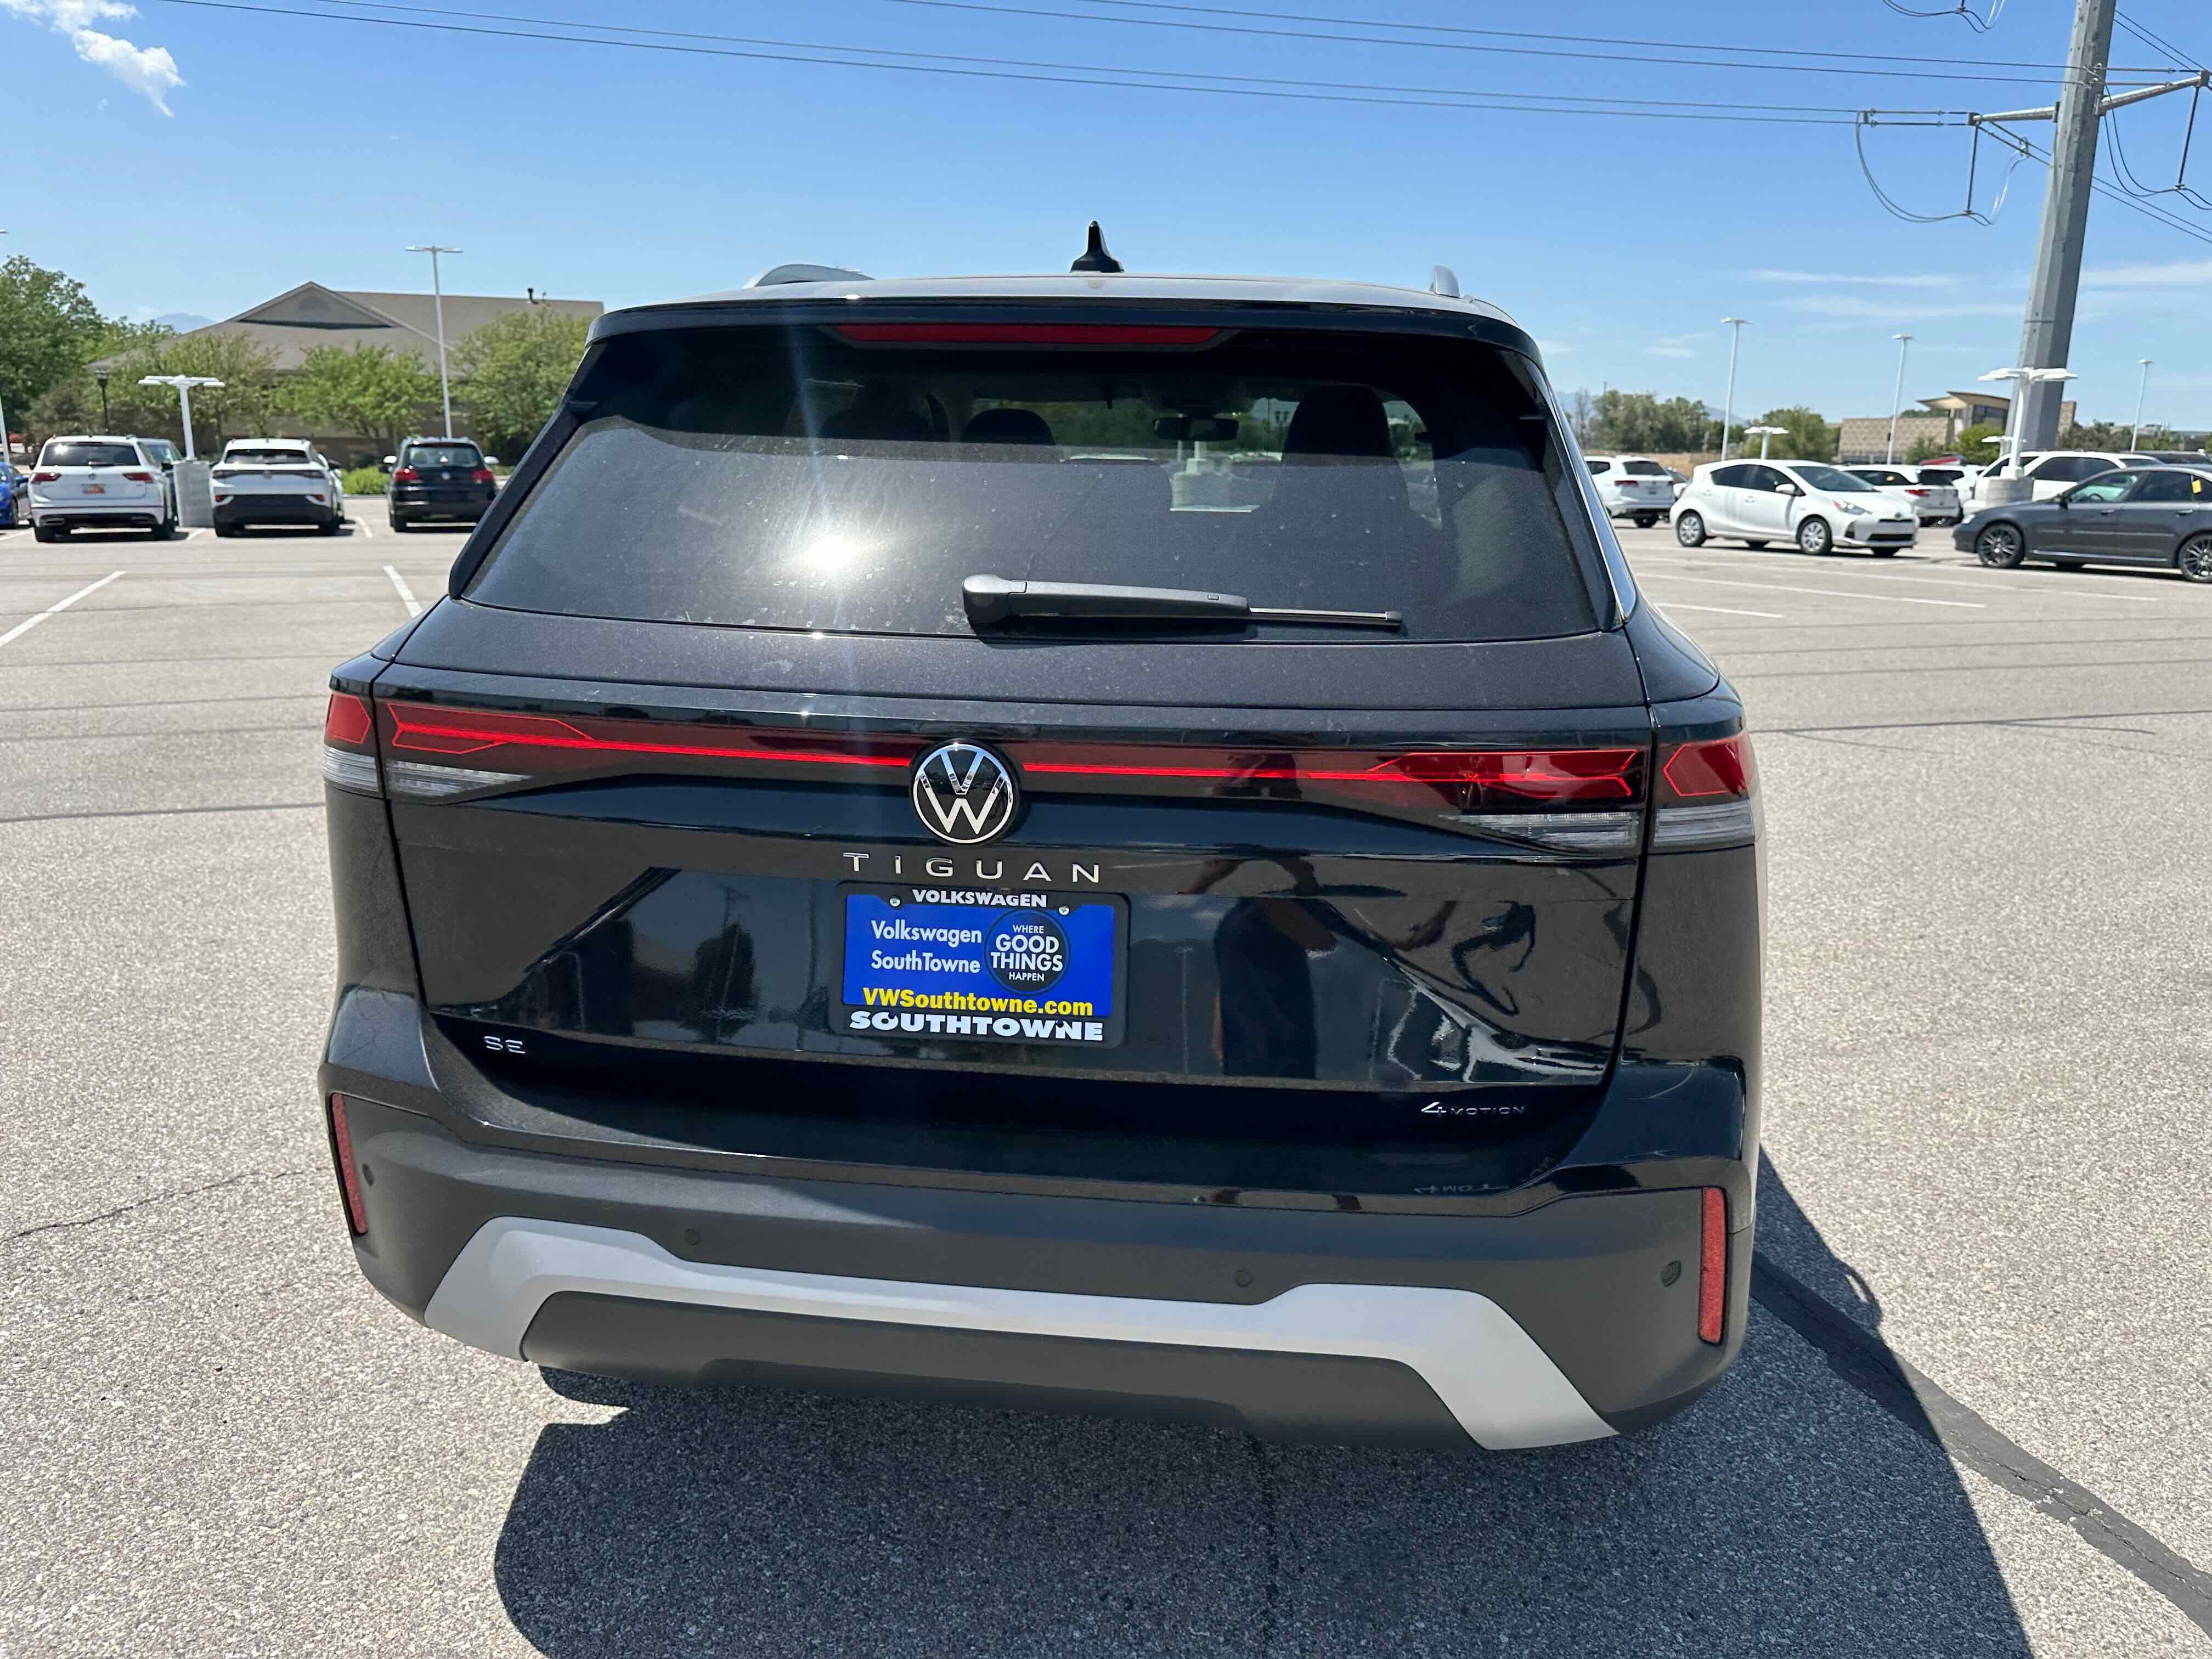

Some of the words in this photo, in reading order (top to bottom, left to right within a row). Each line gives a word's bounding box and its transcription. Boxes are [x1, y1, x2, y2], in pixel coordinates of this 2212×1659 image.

[917, 749, 1008, 835] VW
[843, 852, 1099, 883] TIGUAN
[912, 889, 1047, 908] VOLKSWAGEN
[871, 919, 982, 947] Volkswagen
[1012, 924, 1045, 934] WHERE
[996, 934, 1059, 953] GOOD
[871, 950, 981, 974] SouthTowne
[990, 952, 1063, 972] THINGS
[1009, 972, 1045, 981] HAPPEN
[862, 988, 1093, 1016] VWSouthtowne.com
[849, 1011, 1103, 1041] SOUTHTOWNE
[483, 1036, 526, 1054] SE
